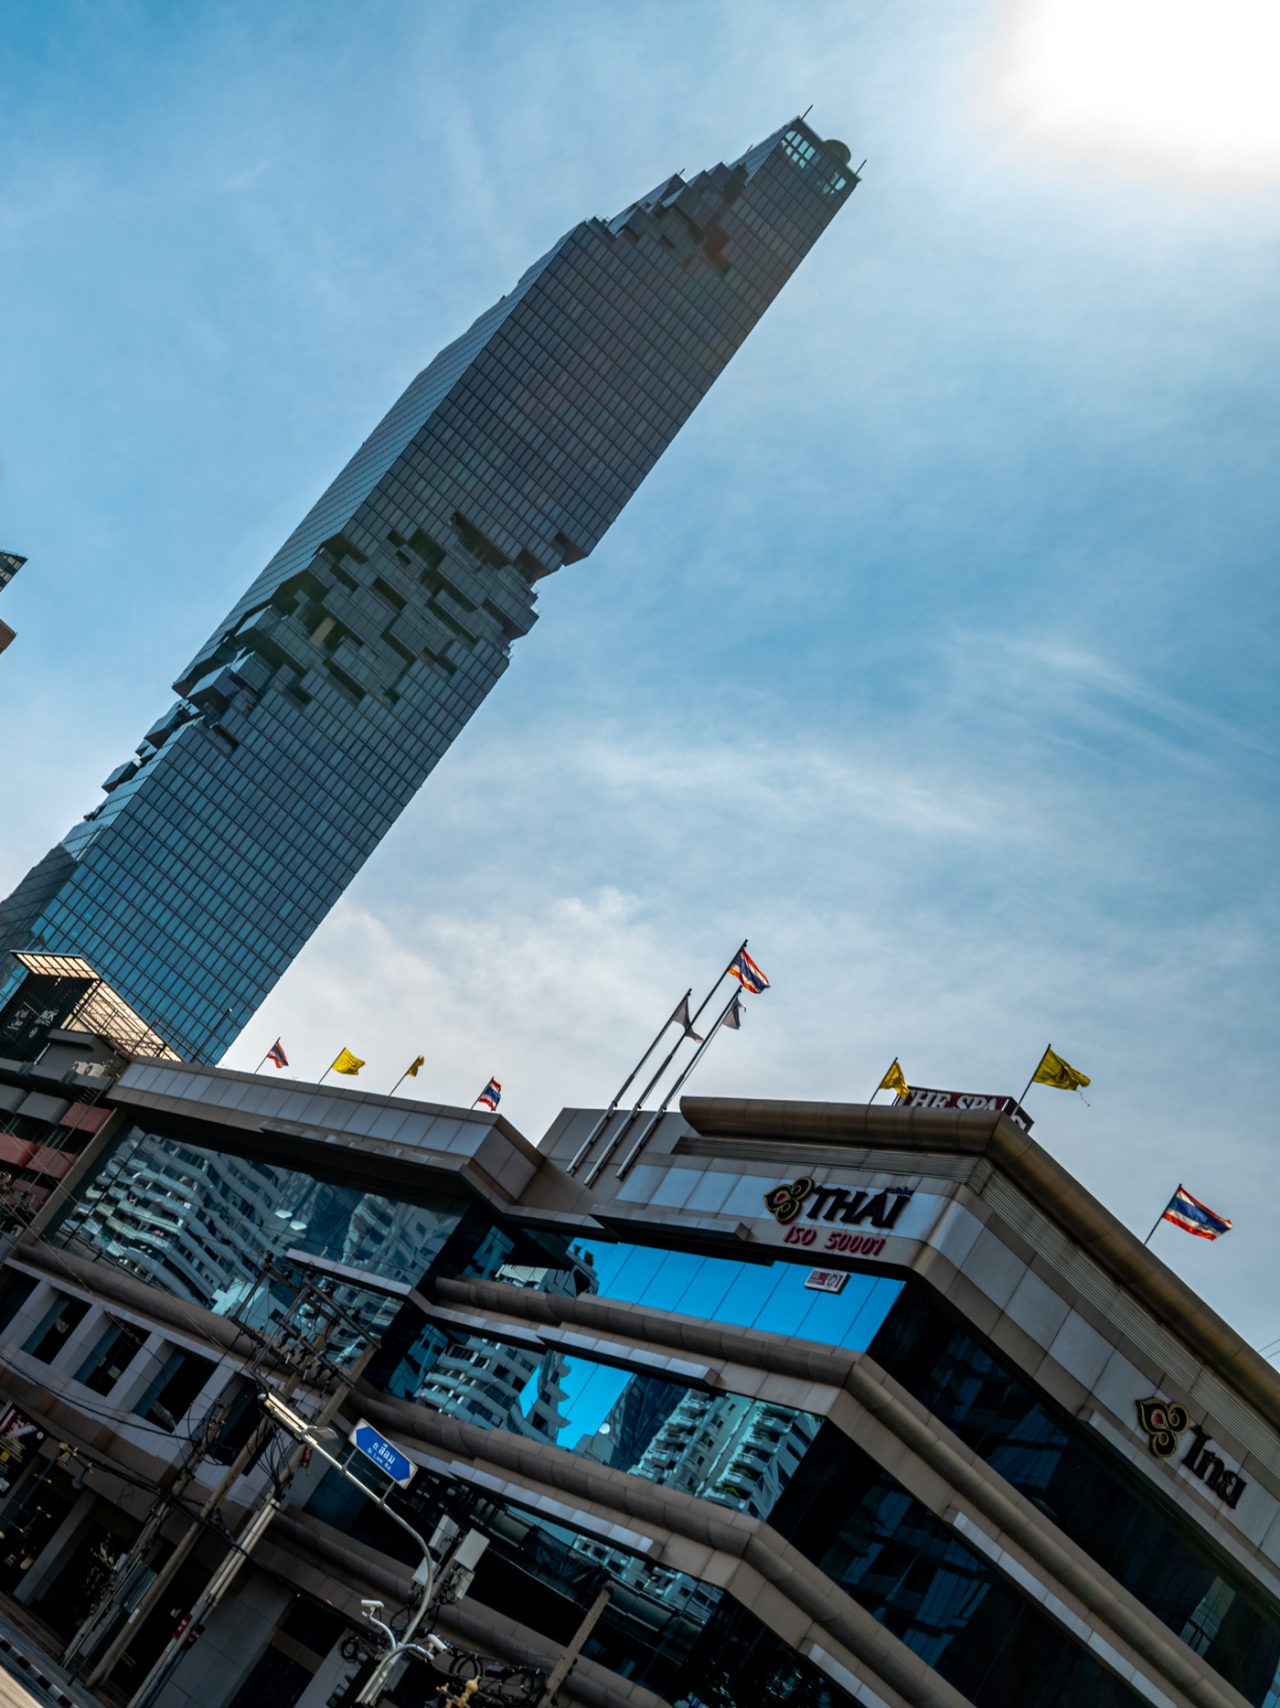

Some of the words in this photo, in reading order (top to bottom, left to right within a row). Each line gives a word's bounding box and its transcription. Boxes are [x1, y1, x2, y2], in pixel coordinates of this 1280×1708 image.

[806, 1184, 913, 1229] THAI
[783, 1225, 817, 1246] ISO
[823, 1231, 886, 1257] 50001
[1180, 1423, 1248, 1510] ไทย
